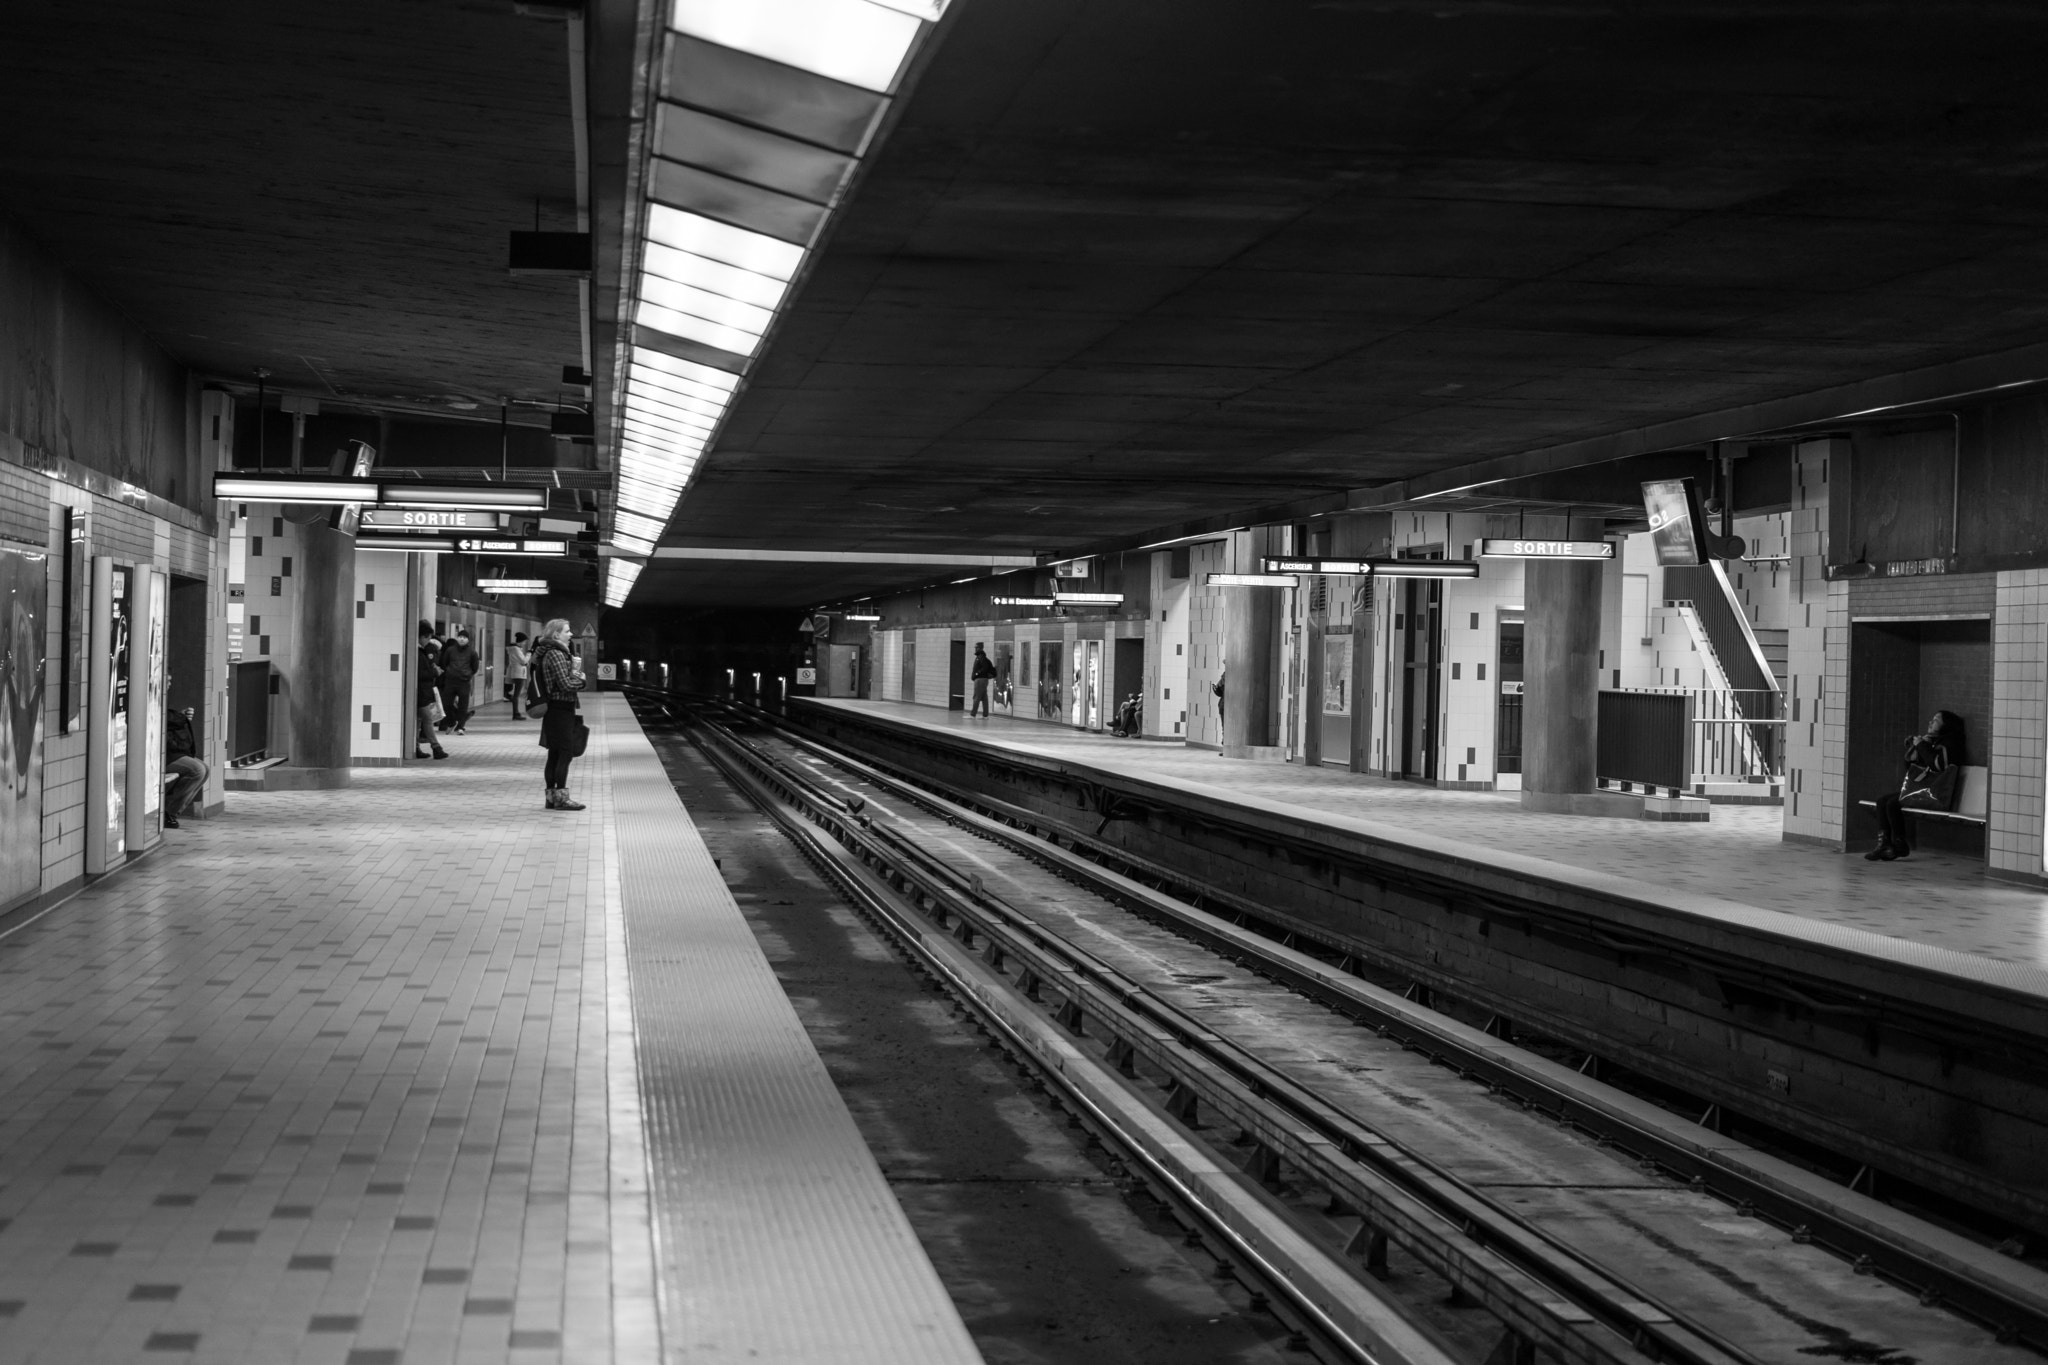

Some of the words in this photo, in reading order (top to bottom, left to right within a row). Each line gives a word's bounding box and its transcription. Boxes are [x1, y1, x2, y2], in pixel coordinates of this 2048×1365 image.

[403, 512, 467, 526] SORTIE
[482, 541, 517, 550] ASCENSEUR
[1513, 542, 1573, 554] SORTIE
[1280, 562, 1313, 571] ASCENSEUR
